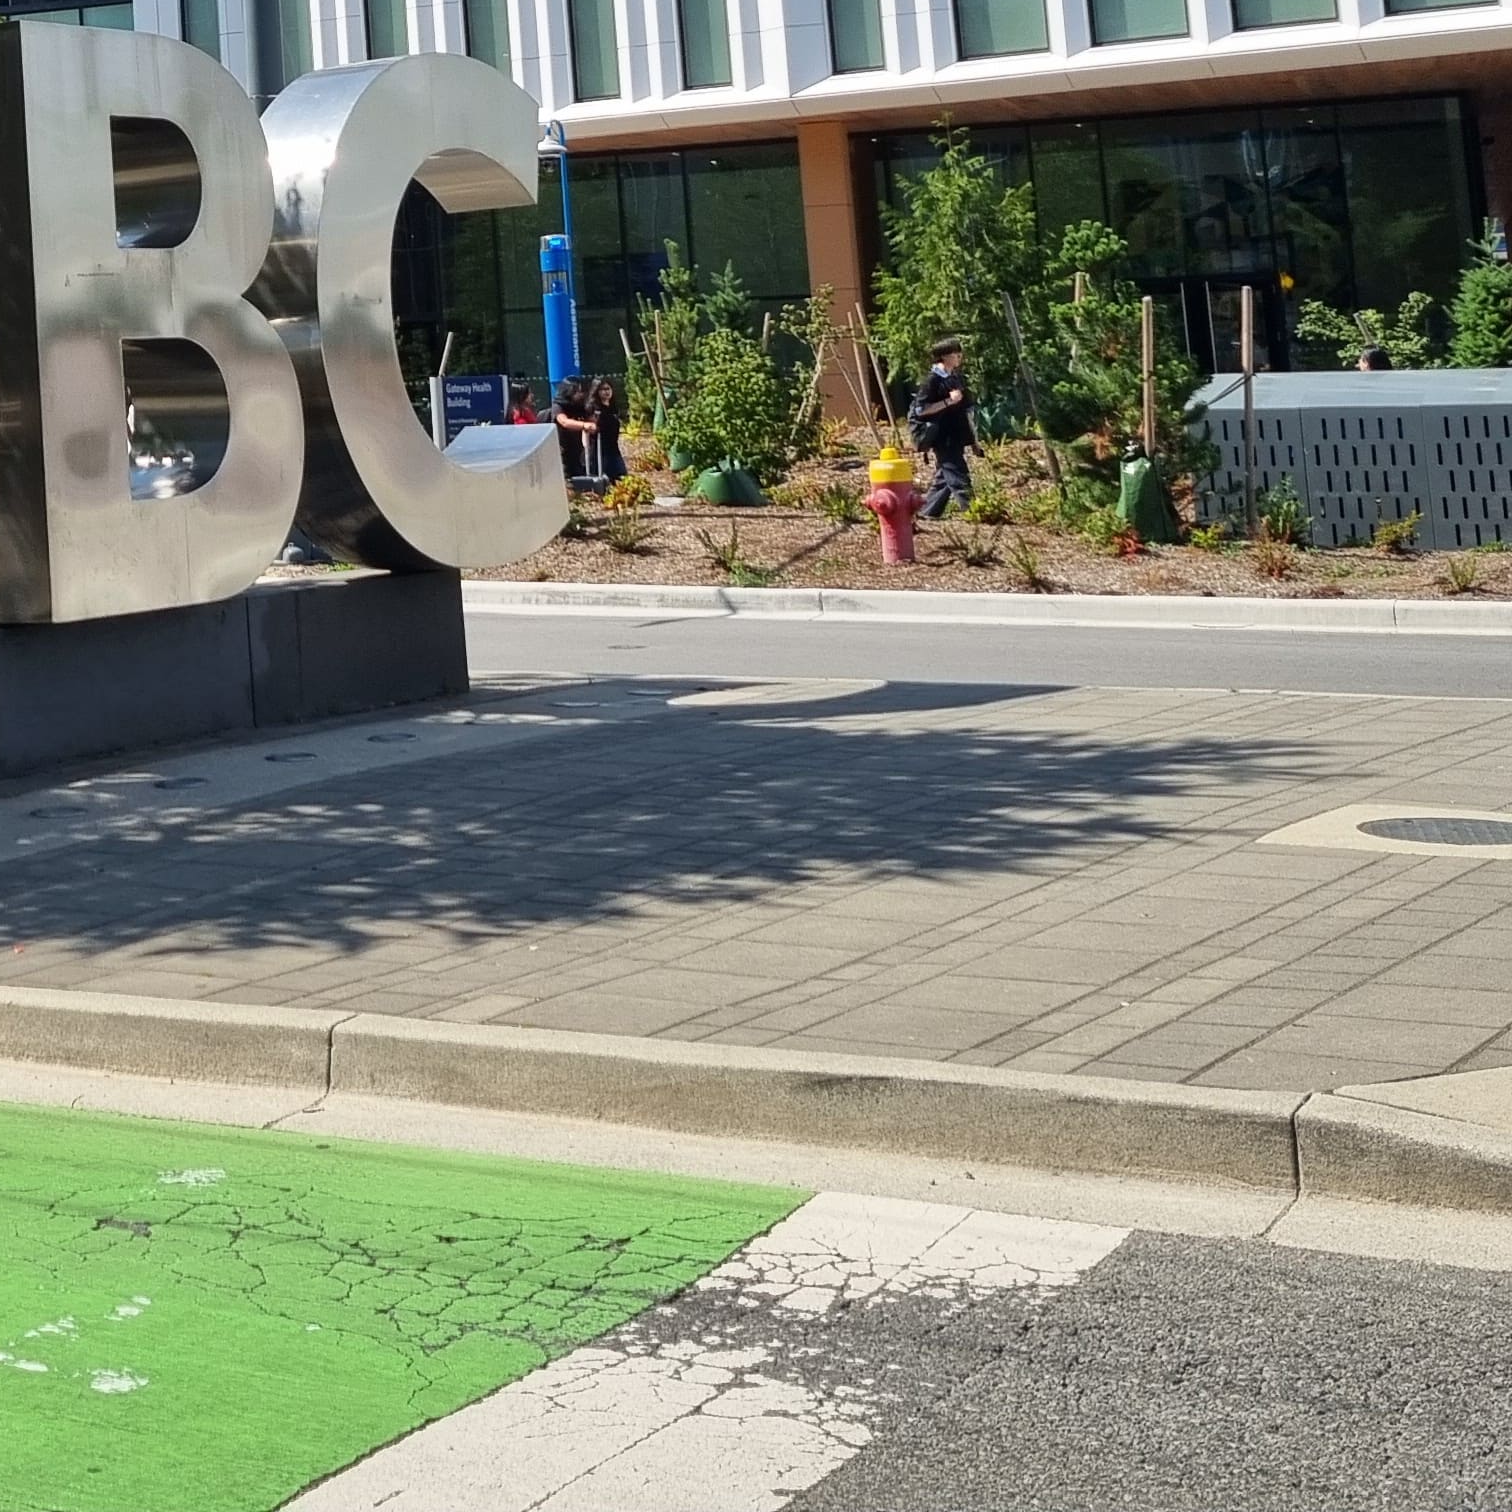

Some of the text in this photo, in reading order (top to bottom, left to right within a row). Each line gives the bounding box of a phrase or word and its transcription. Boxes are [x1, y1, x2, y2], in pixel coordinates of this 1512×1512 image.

[570, 298, 580, 368] Assistance
[446, 382, 492, 395] Gateway Health
[447, 397, 471, 408] Building
